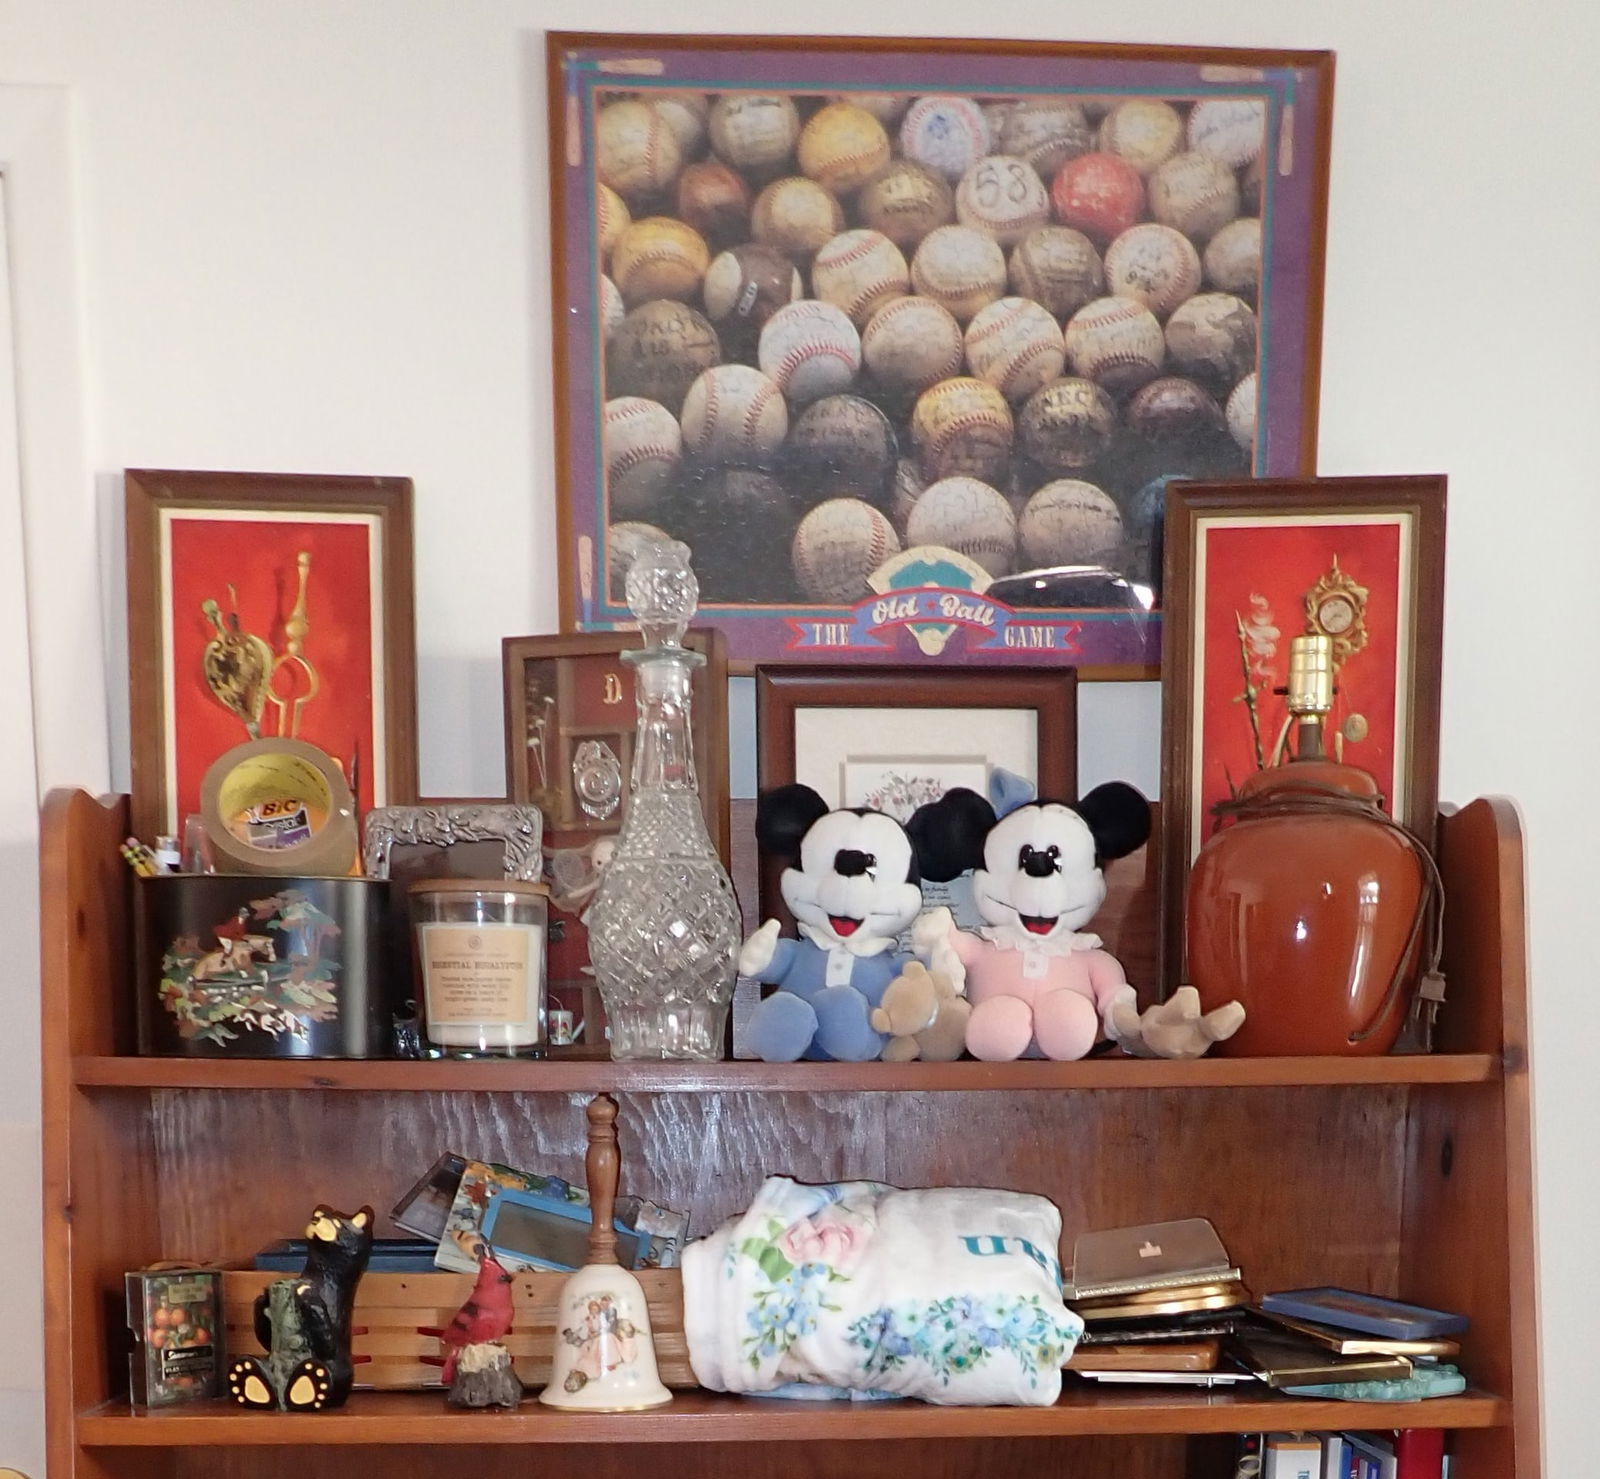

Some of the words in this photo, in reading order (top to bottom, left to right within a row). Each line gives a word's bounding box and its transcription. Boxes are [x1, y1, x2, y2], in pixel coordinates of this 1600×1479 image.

[872, 596, 919, 624] Old
[939, 594, 995, 626] Ball
[812, 623, 849, 646] THE
[1004, 626, 1055, 648] GAME
